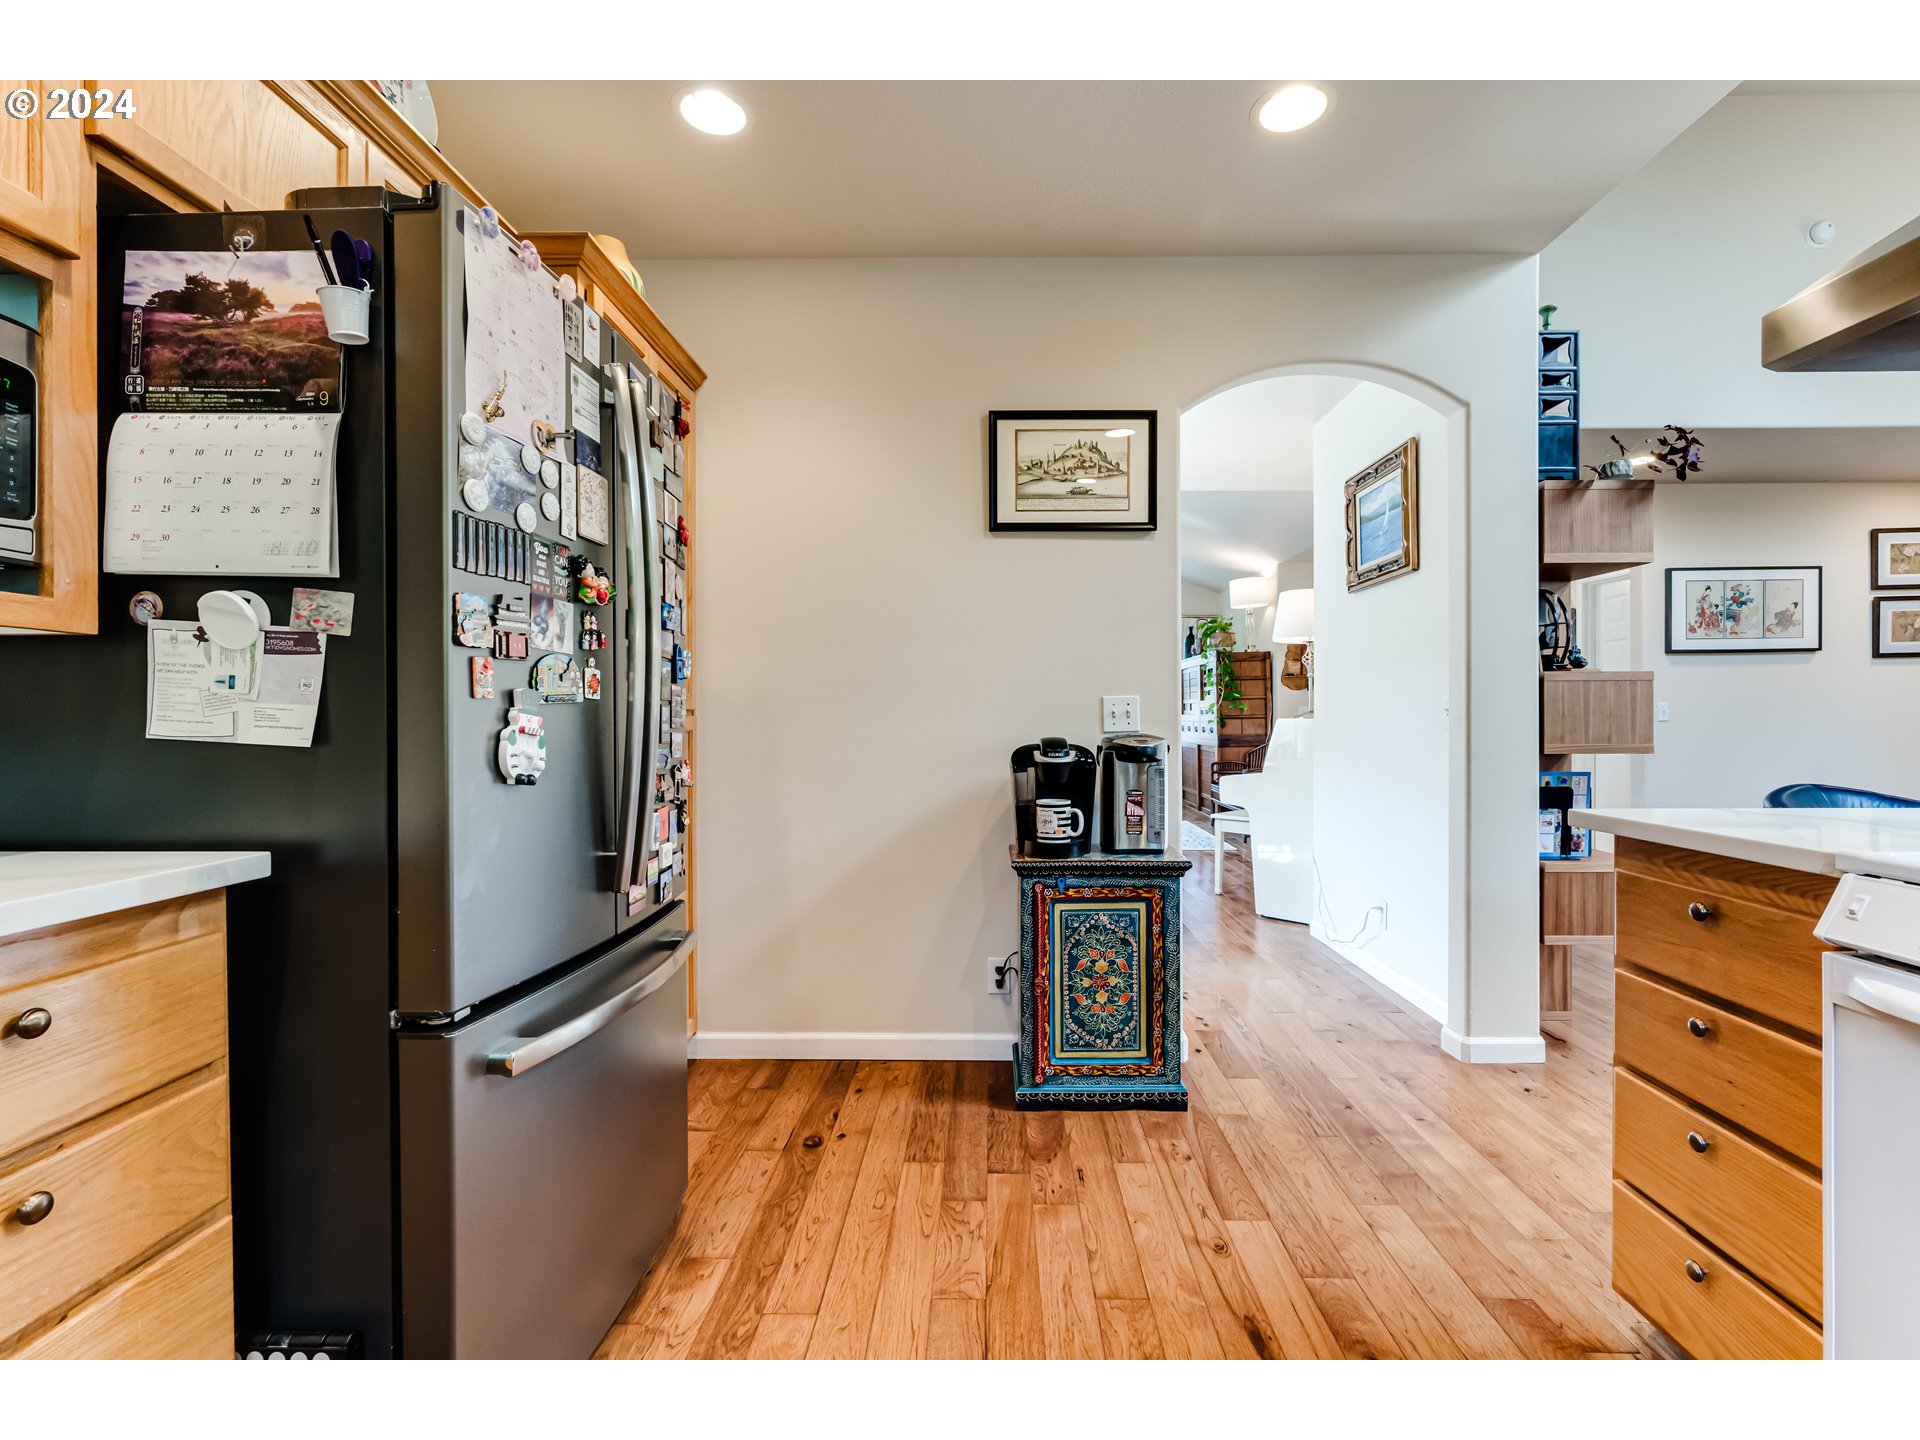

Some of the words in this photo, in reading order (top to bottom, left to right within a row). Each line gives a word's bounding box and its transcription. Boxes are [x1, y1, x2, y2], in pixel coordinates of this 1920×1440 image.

[319, 391, 329, 406] 9
[138, 448, 145, 456] 8
[168, 448, 175, 457] 9
[194, 448, 205, 456] 10
[224, 449, 233, 457] 11
[254, 449, 264, 457] 12
[283, 449, 293, 458] 13
[313, 450, 323, 458] 14
[133, 475, 143, 484] 15
[163, 476, 172, 484] 16
[192, 476, 203, 485] 17
[222, 477, 232, 485] 18
[252, 477, 262, 486] 19
[280, 477, 292, 486] 20
[310, 478, 321, 486] 21
[131, 504, 142, 513] 22
[160, 504, 171, 513] 23
[190, 505, 200, 513] 24
[220, 505, 231, 514] 25
[250, 506, 261, 514] 26
[280, 506, 291, 515] 27
[310, 506, 321, 515] 28
[130, 533, 141, 541] 29
[159, 533, 171, 542] 30
[554, 555, 568, 568] CAN
[555, 575, 568, 588] YOU
